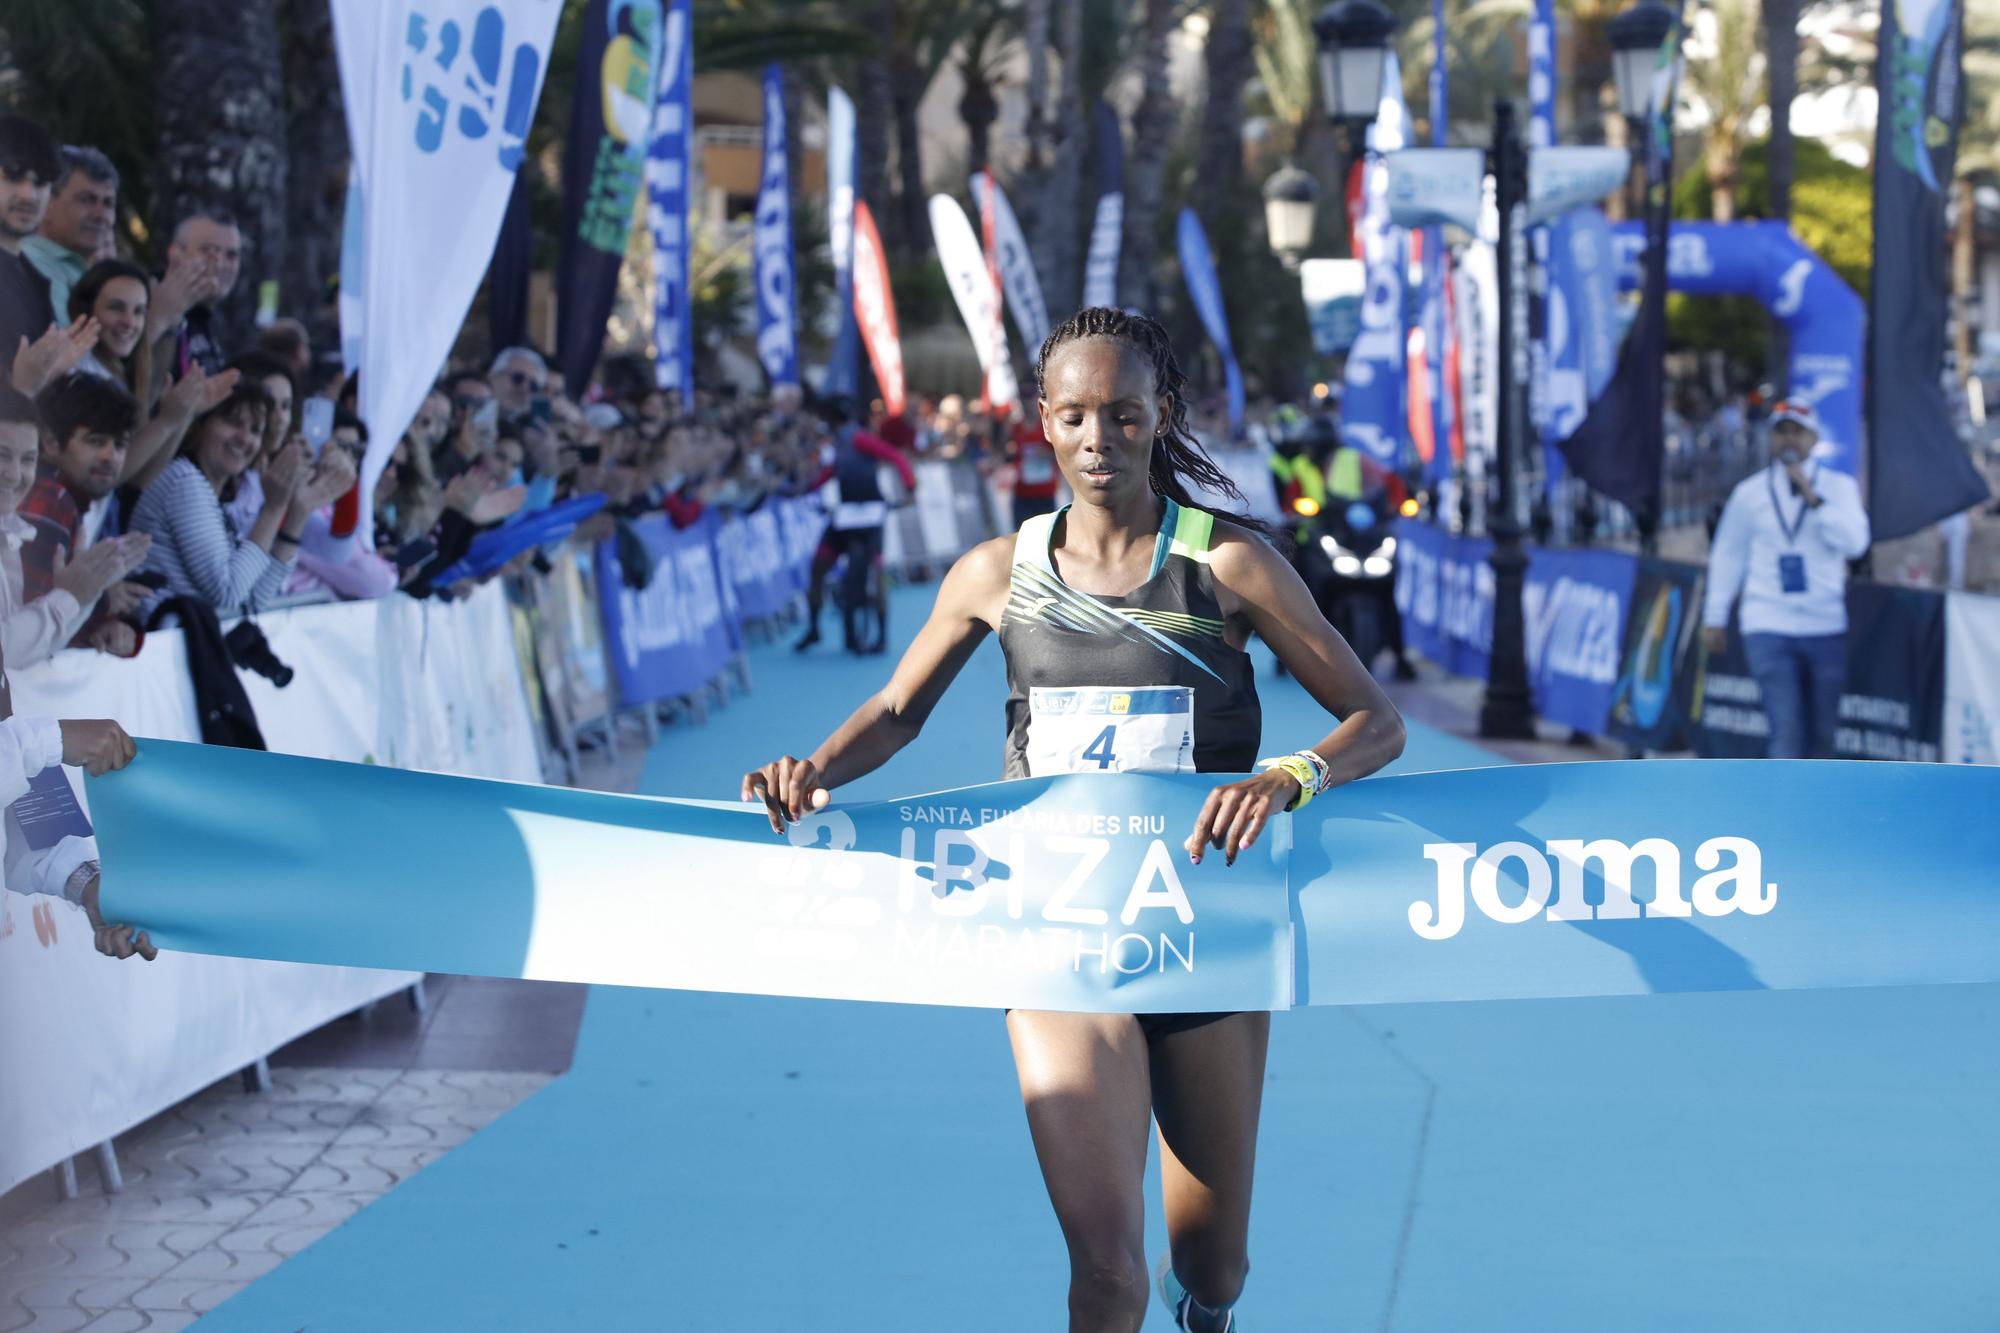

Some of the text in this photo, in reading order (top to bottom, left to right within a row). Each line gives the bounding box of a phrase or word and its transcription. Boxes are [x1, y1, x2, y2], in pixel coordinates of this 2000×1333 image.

[1082, 724, 1117, 770] 4
[900, 805, 974, 825] SANTA
[1075, 815, 1121, 834] DES
[1129, 815, 1165, 834] RIU
[897, 826, 1195, 926] IBIZA
[893, 919, 1195, 974] MARATHON
